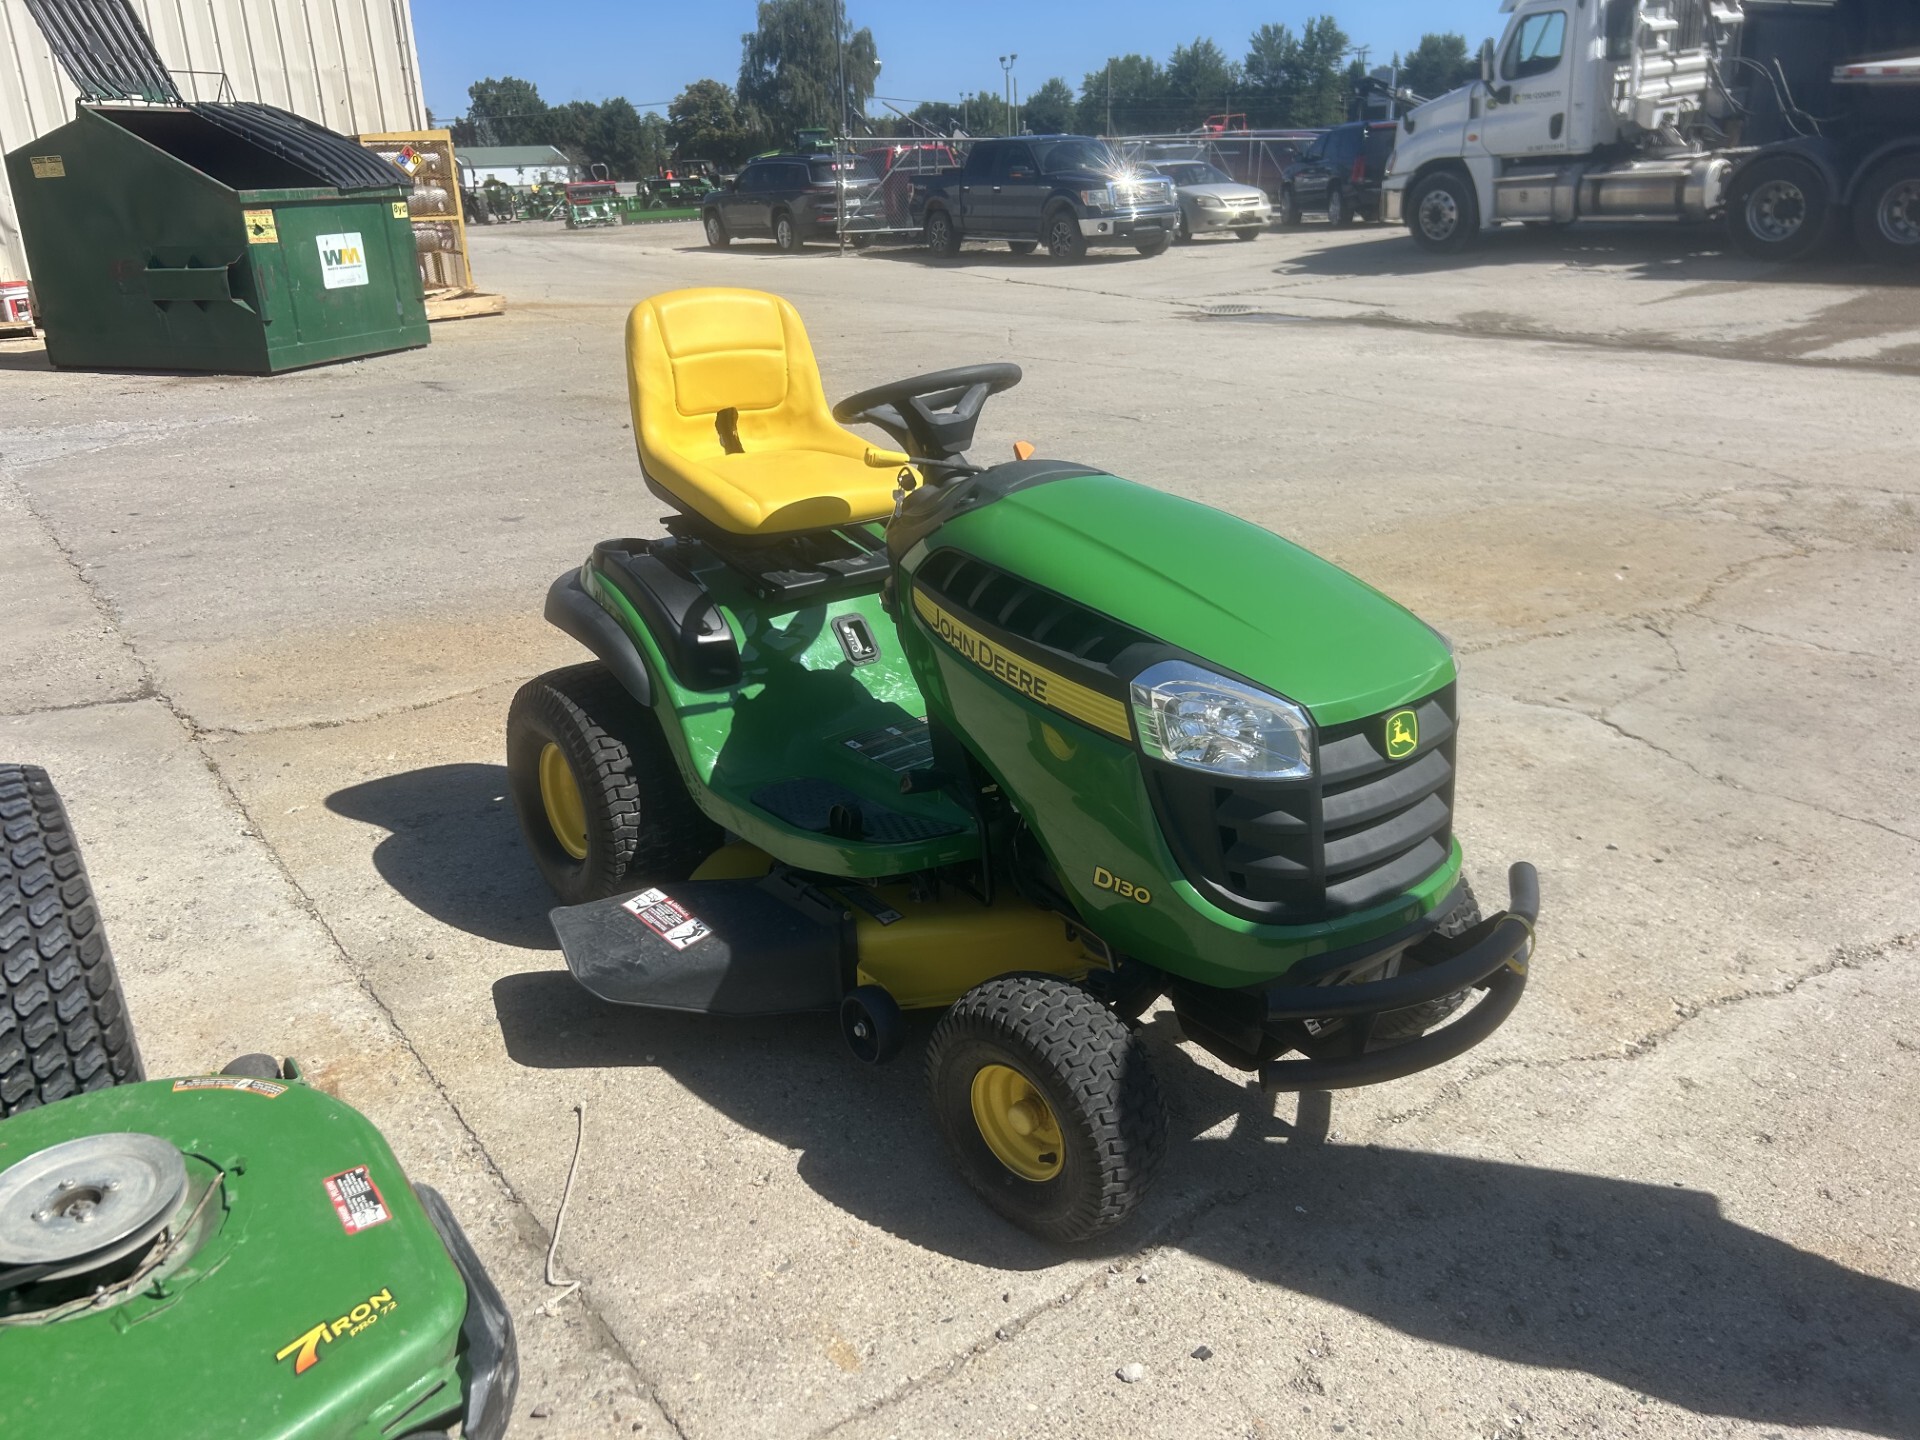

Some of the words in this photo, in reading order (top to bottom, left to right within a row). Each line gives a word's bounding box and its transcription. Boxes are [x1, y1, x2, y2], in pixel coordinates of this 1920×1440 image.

[322, 247, 361, 266] WM
[931, 608, 975, 660] JOHN
[978, 640, 1048, 702] DEERE
[1093, 866, 1151, 905] D130
[349, 1314, 378, 1337] PRO
[380, 1301, 398, 1316] 72
